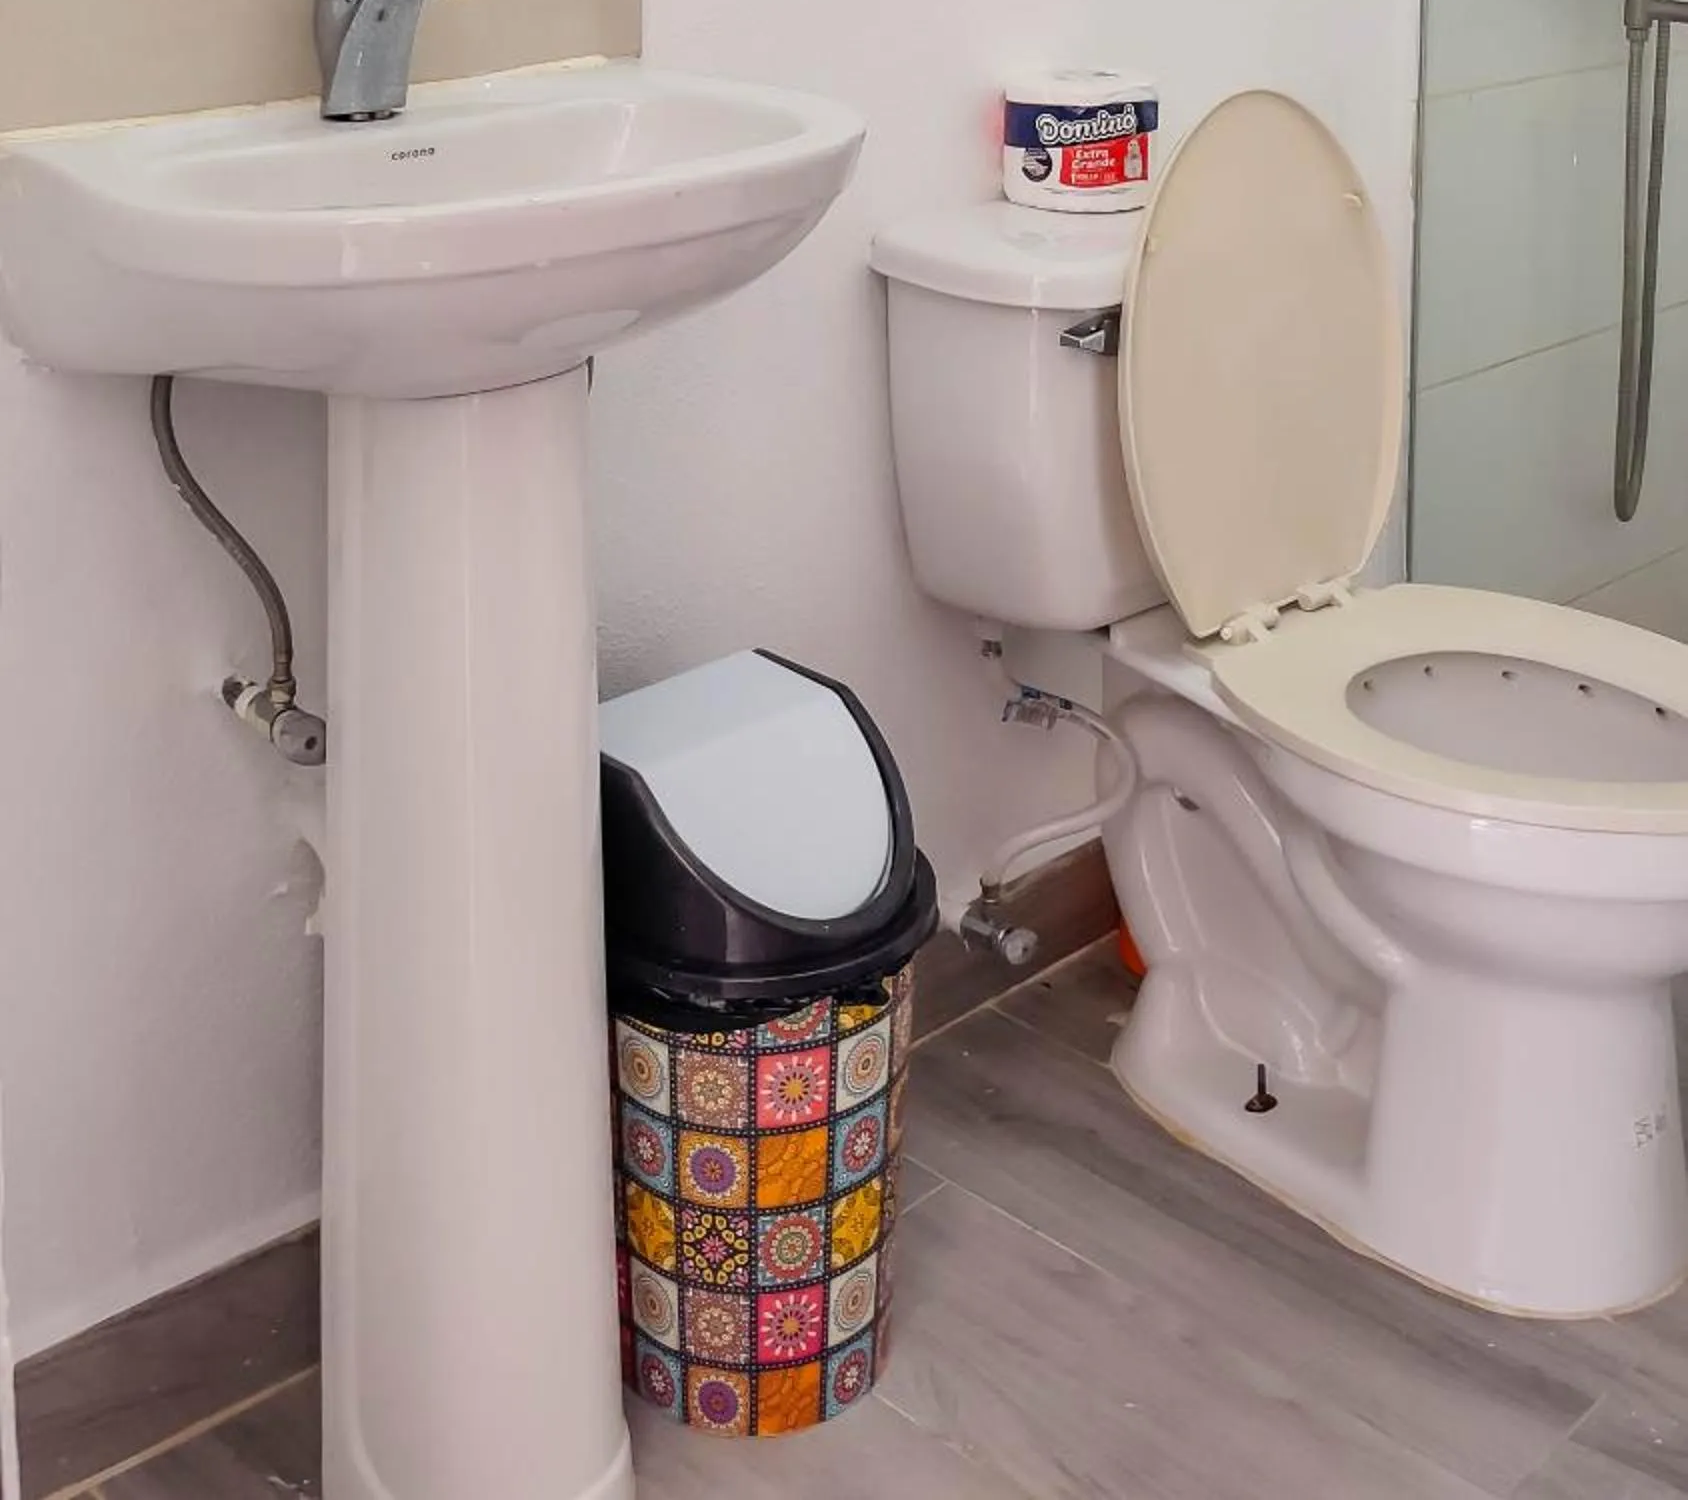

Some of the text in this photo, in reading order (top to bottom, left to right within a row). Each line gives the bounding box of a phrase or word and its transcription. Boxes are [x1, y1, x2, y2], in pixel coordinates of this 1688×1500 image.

[391, 147, 435, 161] corona
[1075, 149, 1109, 159] Extra
[1071, 158, 1116, 169] Grande
